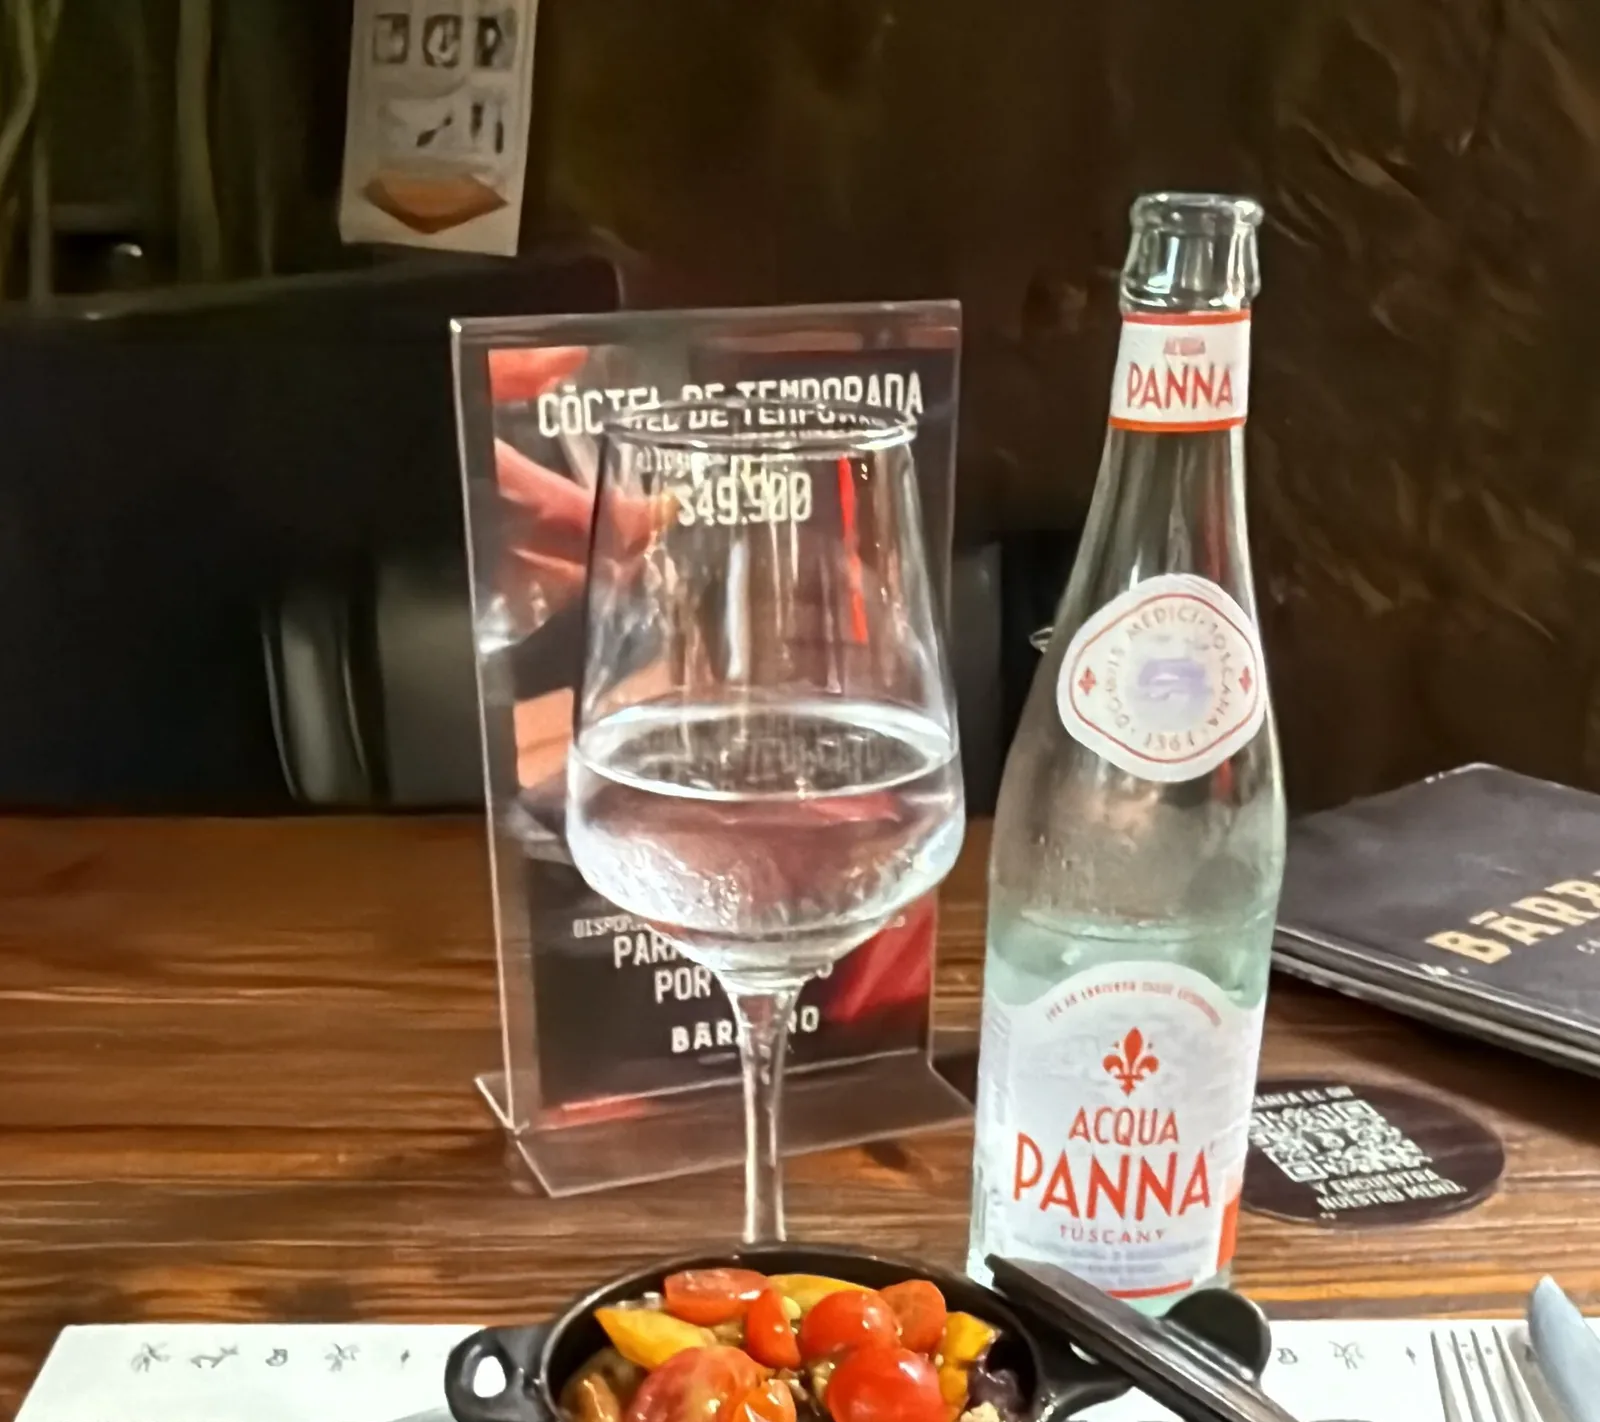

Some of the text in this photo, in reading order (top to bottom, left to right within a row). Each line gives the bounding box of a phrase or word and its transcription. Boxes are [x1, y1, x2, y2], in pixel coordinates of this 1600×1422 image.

[682, 383, 730, 430] DE
[1126, 361, 1233, 410] PANNA
[654, 966, 711, 1004] POR
[1068, 1105, 1180, 1147] ACQUA
[1013, 1130, 1212, 1222] PANNA
[1059, 1223, 1166, 1245] TUSCANY
